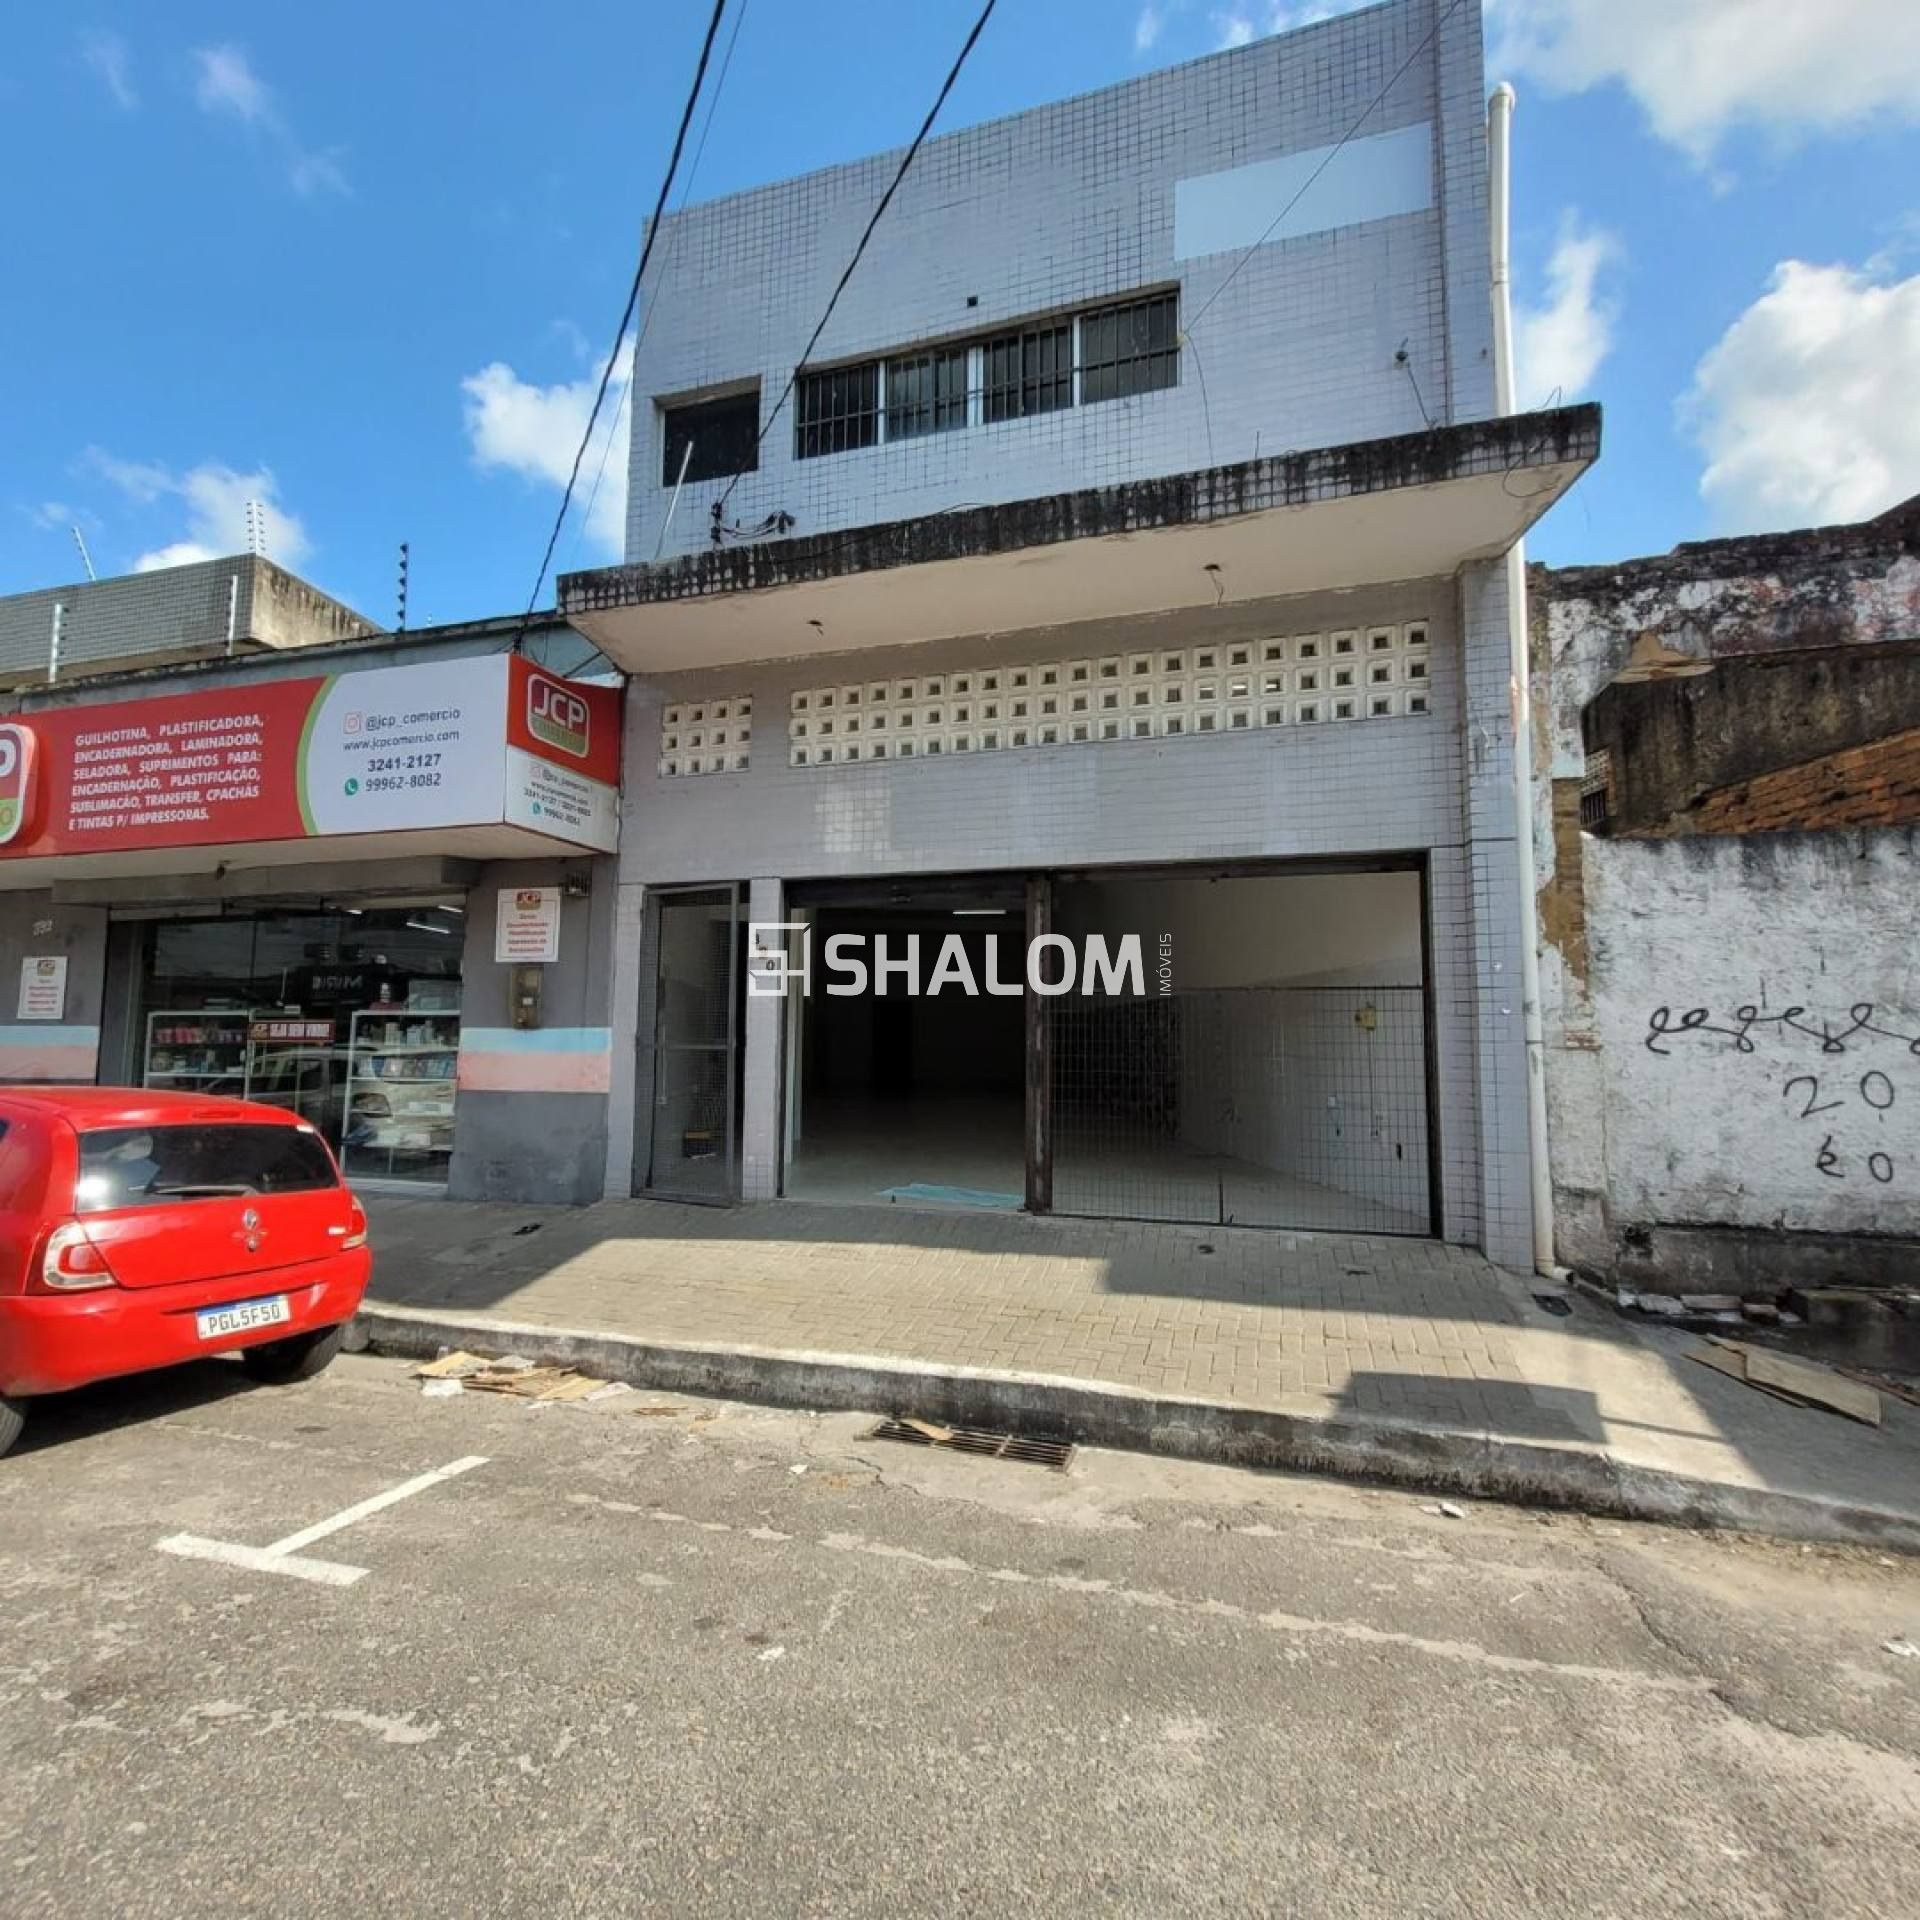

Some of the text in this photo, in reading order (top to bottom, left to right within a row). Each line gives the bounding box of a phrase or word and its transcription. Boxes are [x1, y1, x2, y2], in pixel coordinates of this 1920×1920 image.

[366, 707, 461, 731] @jcp_comercio
[533, 686, 585, 730] JCP
[75, 714, 264, 746] GUILHOTINA, PLASTIFICADORA,
[343, 731, 459, 752] www.jcpcomercio.com
[74, 733, 264, 764] ENCADERNADORA, LAMINADORA,
[73, 763, 132, 780] SELADORA,
[139, 753, 219, 773] SUPRIMENTOS
[367, 753, 442, 772] 3241-2127
[72, 766, 261, 797] ENCADERNAÇÃO, PLASTIFICAÇÃO,
[365, 773, 442, 792] 99962-8082
[68, 807, 210, 831] E TINTAS P/ IMPRESSORAS.
[208, 1304, 281, 1334] PGL5F50
